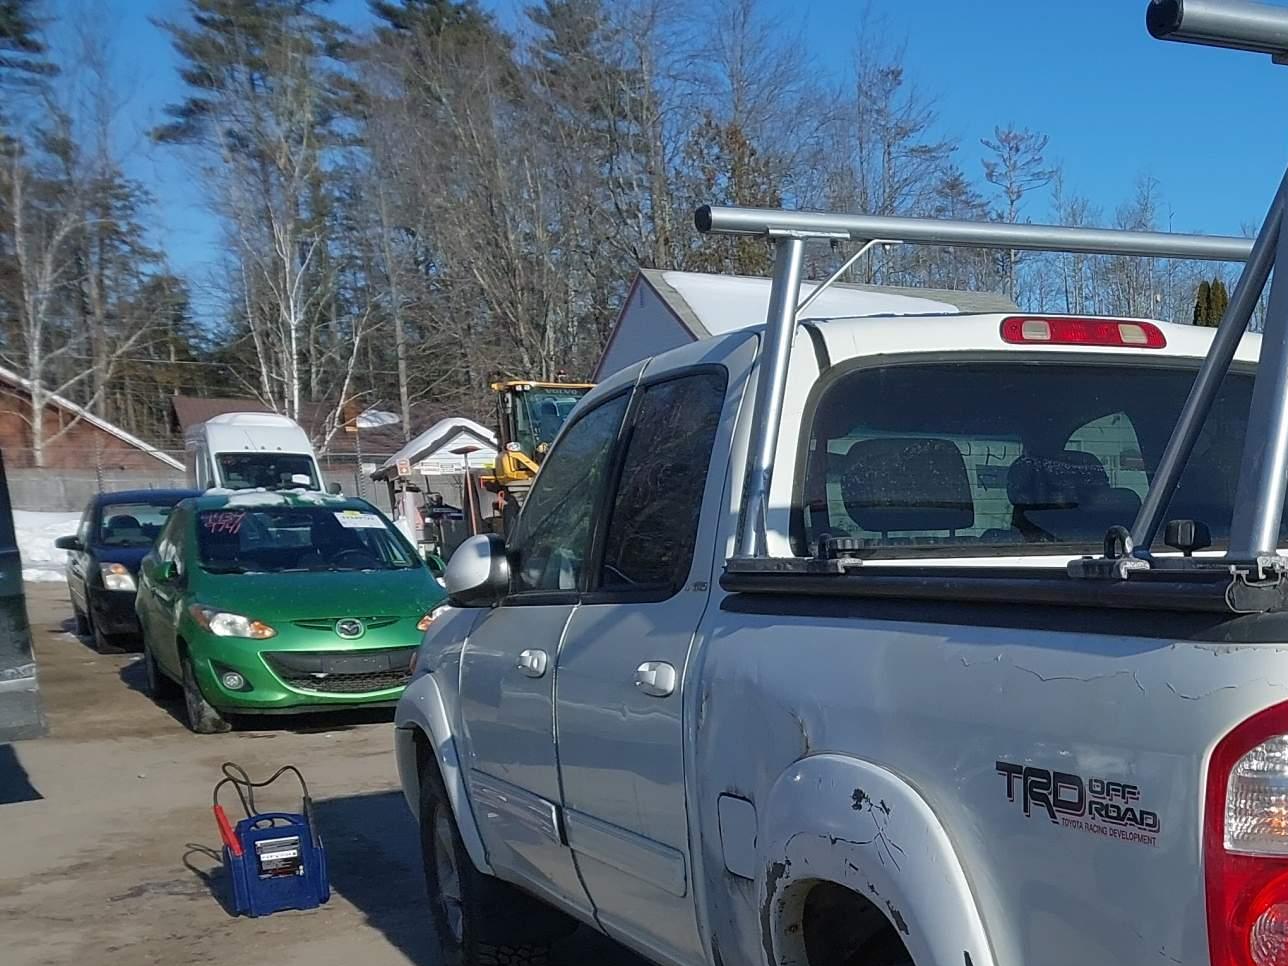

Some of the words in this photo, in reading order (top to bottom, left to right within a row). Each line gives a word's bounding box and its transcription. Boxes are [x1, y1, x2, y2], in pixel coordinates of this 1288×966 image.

[996, 761, 1087, 824] TRD
[1088, 778, 1140, 804] OFF
[1062, 817, 1084, 831] TOYOTA
[1084, 822, 1108, 836] RACING
[1109, 827, 1157, 847] DEVELOPMENT
[1088, 800, 1160, 833] ROAD
